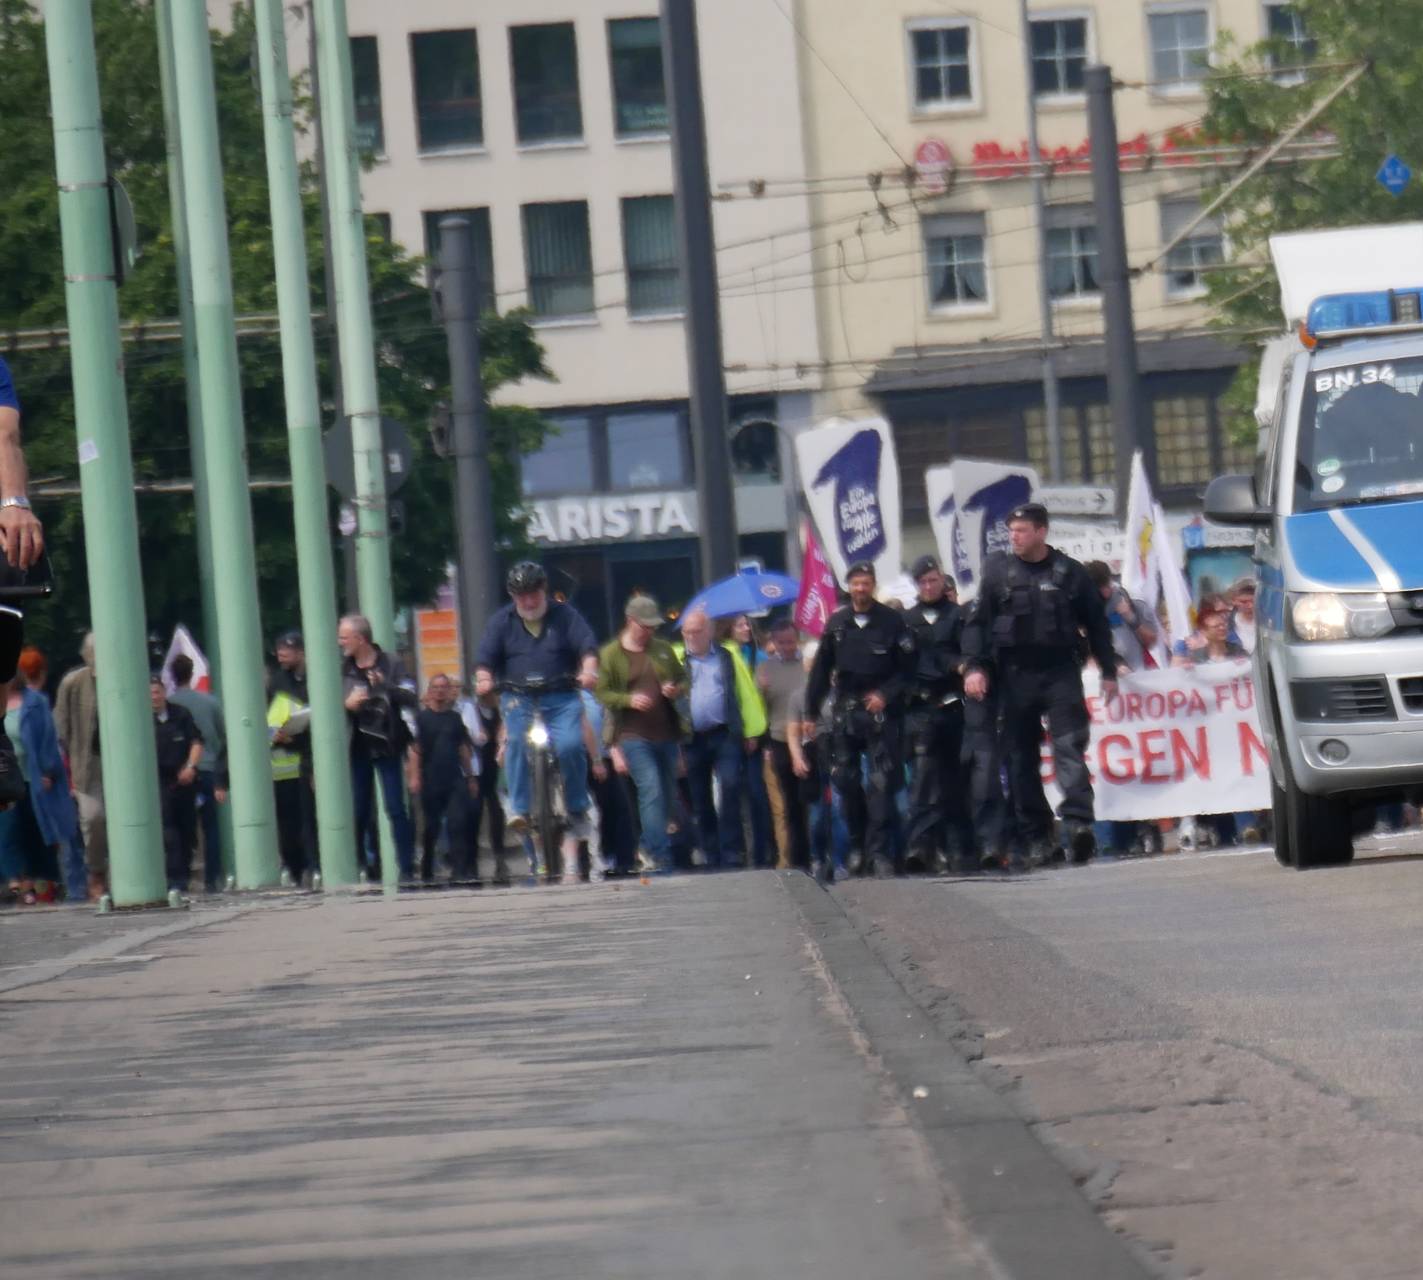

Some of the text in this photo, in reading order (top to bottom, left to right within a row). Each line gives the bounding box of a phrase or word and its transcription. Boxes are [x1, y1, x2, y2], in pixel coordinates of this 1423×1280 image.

[1315, 364, 1396, 392] BN 34
[527, 497, 694, 543] ARISTA
[1086, 676, 1254, 726] EUROPA FÜ
[1237, 721, 1269, 775] N
